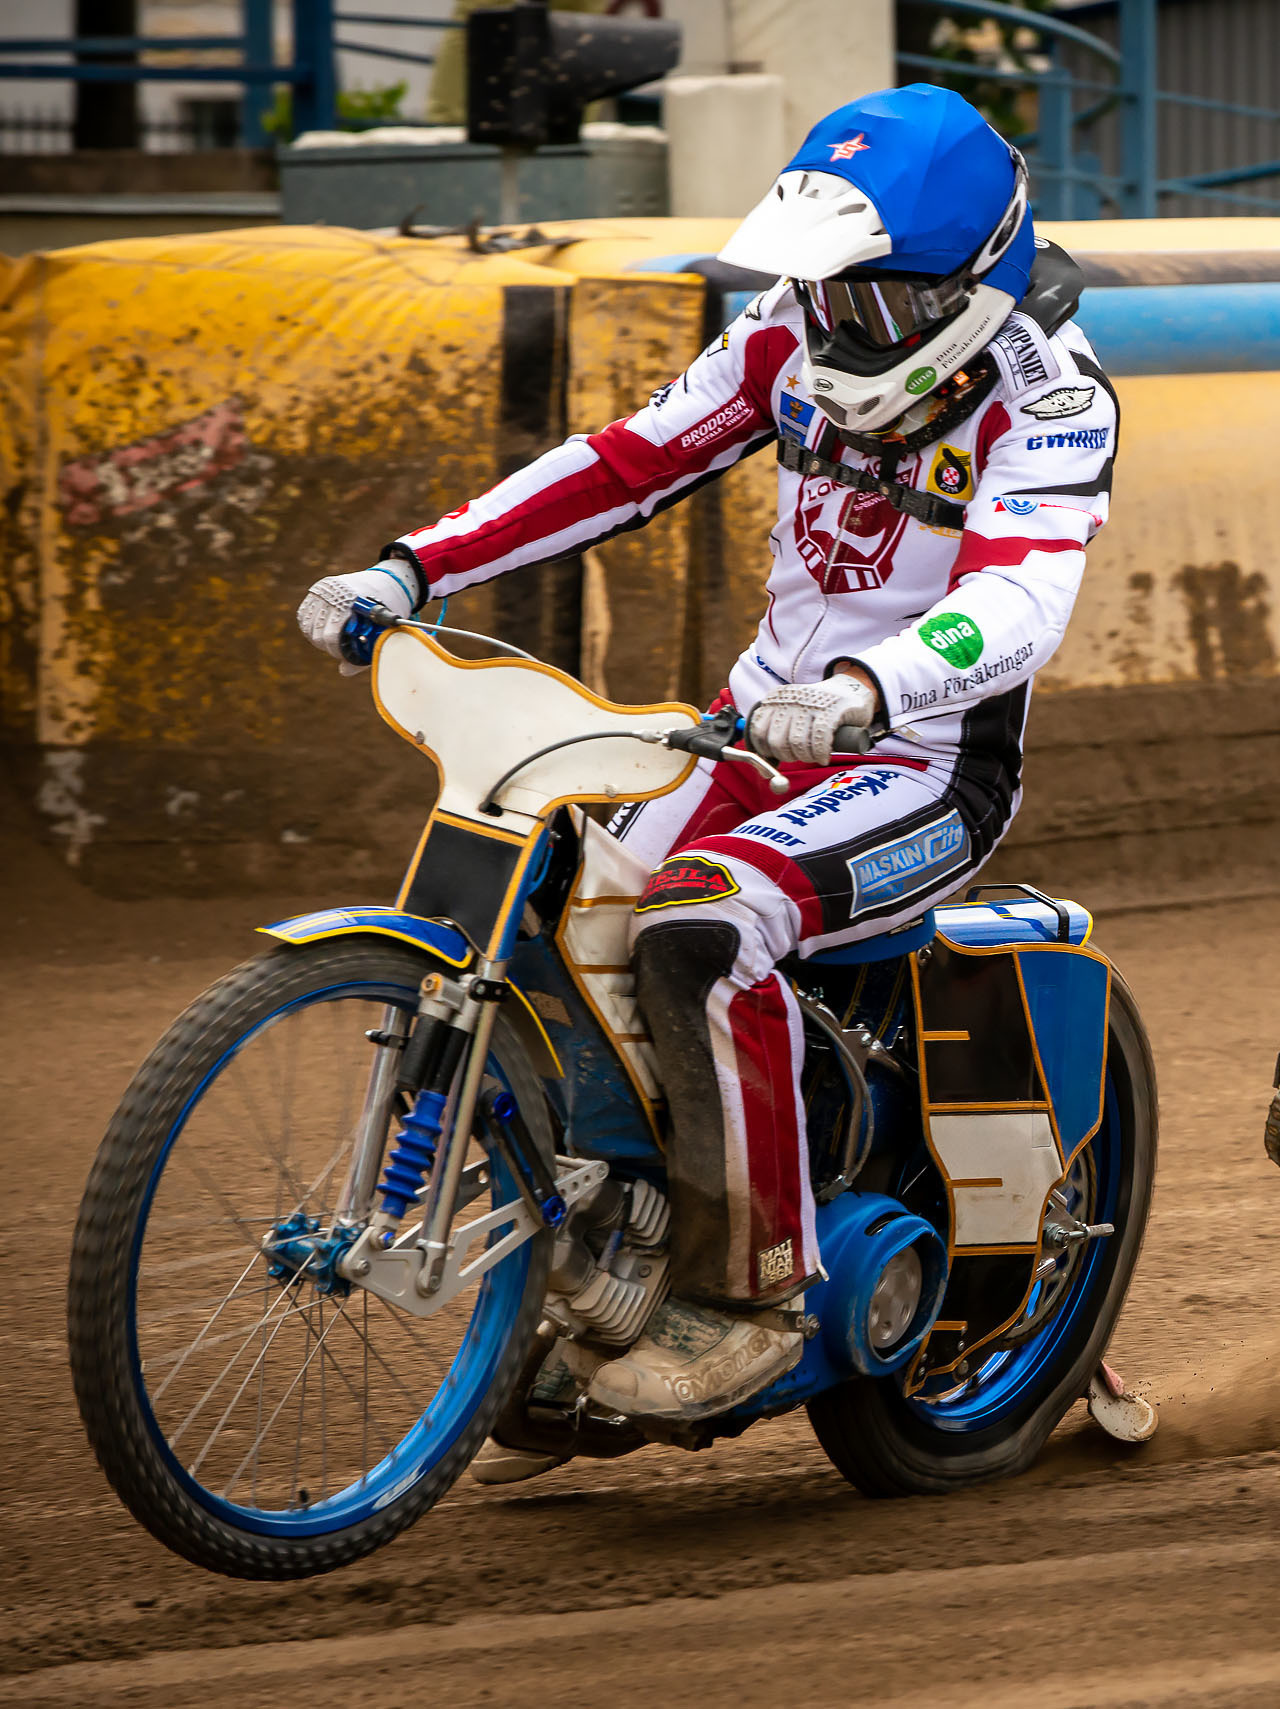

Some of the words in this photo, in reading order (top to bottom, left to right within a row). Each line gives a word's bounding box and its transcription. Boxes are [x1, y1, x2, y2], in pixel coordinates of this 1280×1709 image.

[1004, 319, 1048, 385] OMPANIET
[680, 396, 748, 448] BRODDSON
[930, 620, 976, 650] dina
[900, 690, 938, 714] Dina
[943, 641, 1035, 699] Försäkringar
